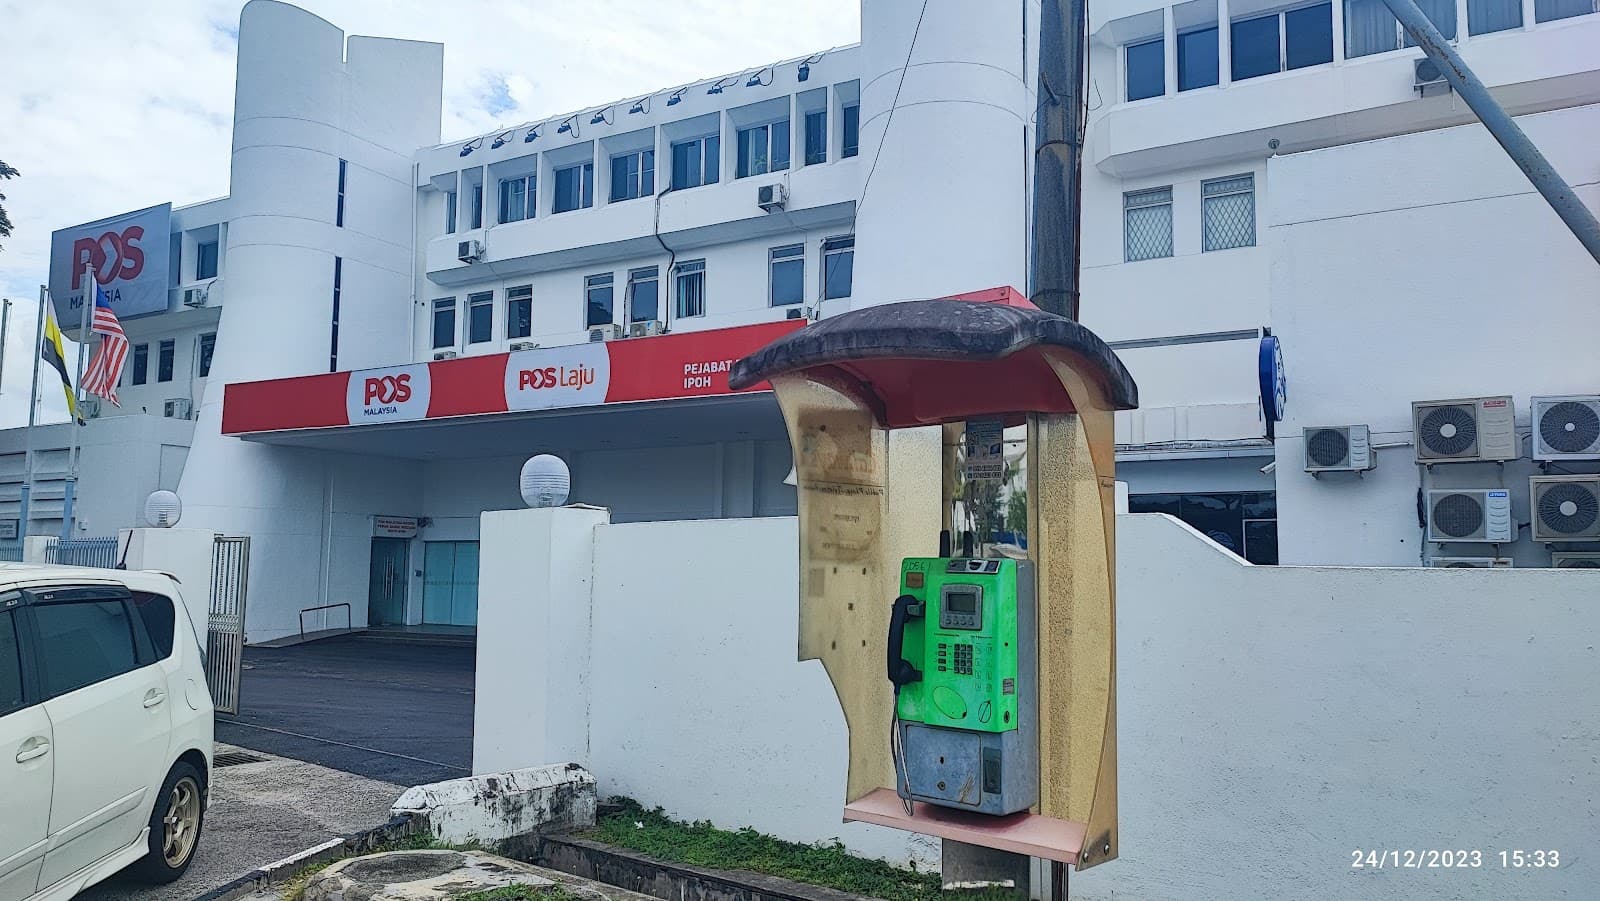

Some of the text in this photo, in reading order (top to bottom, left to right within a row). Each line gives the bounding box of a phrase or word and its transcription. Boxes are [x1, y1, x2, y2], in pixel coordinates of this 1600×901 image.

[72, 226, 145, 290] POS
[70, 288, 122, 310] MASIA
[519, 363, 595, 391] POS Laju
[684, 360, 733, 375] PEJABAT
[364, 373, 412, 406] POS
[683, 376, 711, 389] IPOH
[363, 406, 398, 417] MALAYSIA
